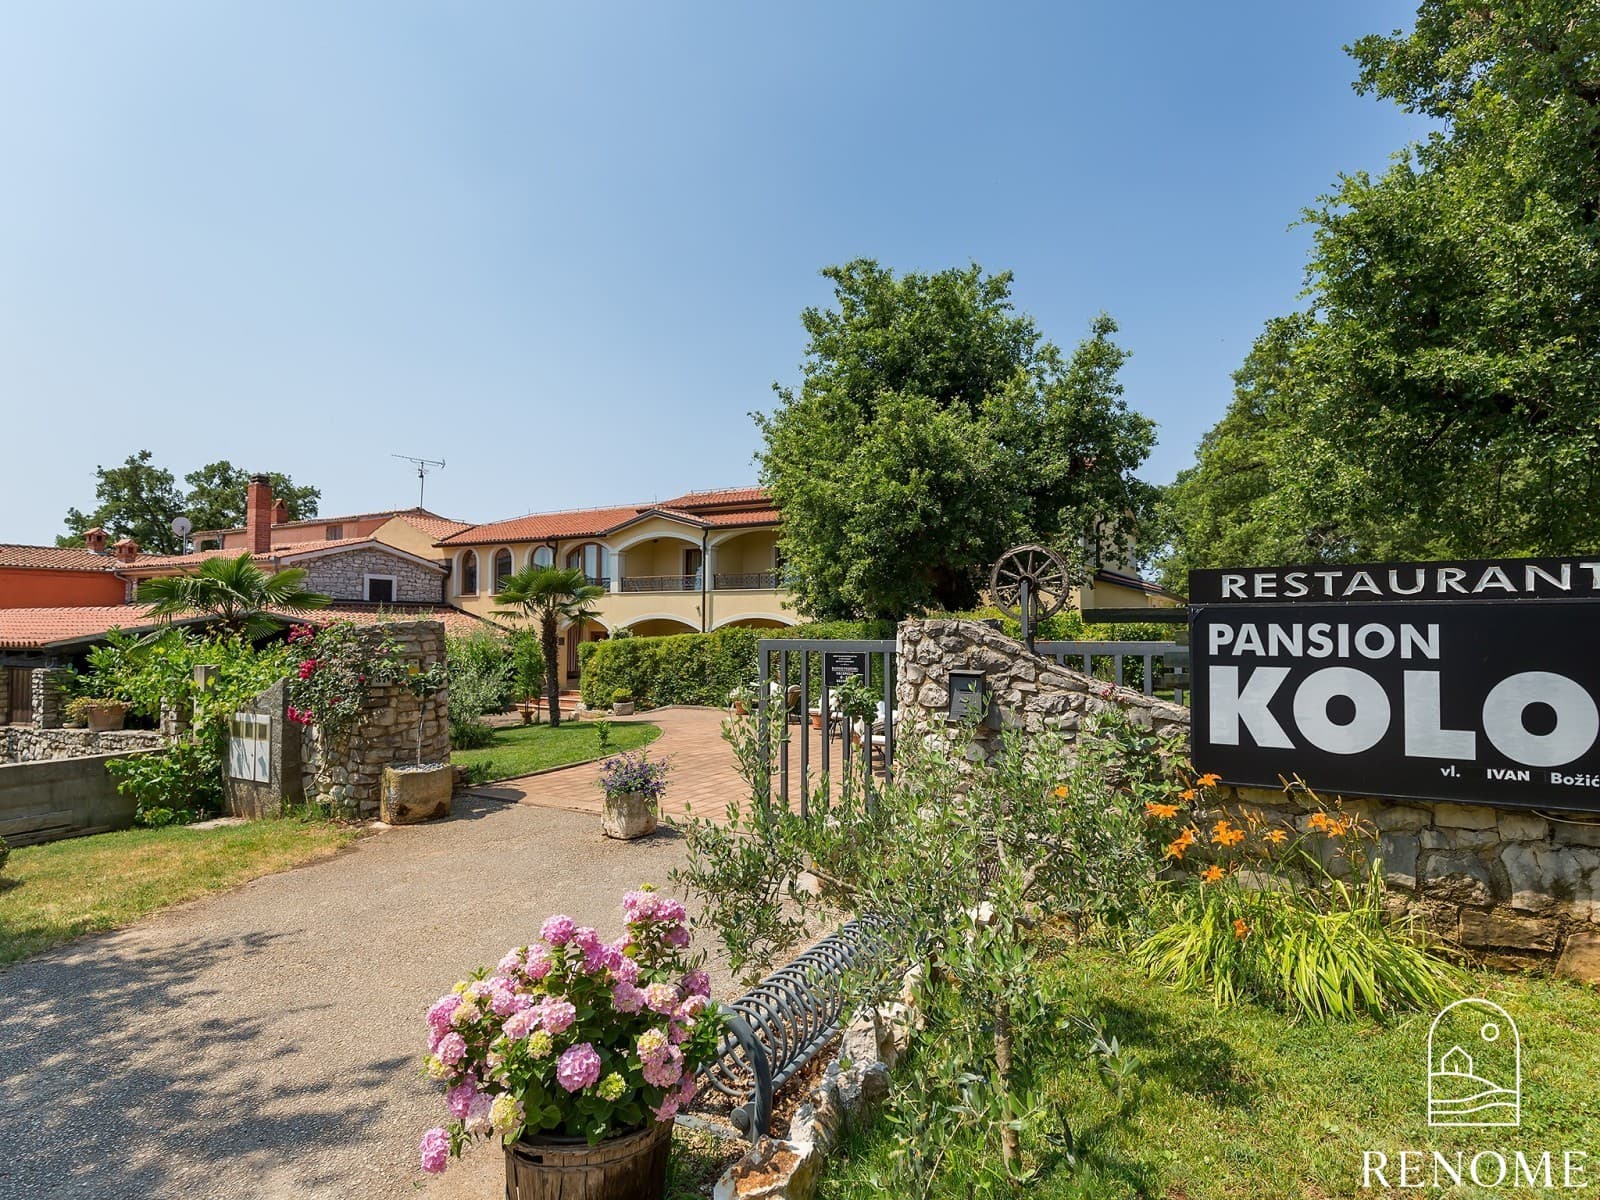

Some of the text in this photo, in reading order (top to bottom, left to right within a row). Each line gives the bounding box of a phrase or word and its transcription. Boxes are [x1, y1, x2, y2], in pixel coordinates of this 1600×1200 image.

[1221, 562, 1600, 598] RESTAURANT
[1209, 623, 1440, 660] PANSION
[1208, 665, 1600, 768] KOLO
[1440, 765, 1600, 788] vl. IVAN Božić
